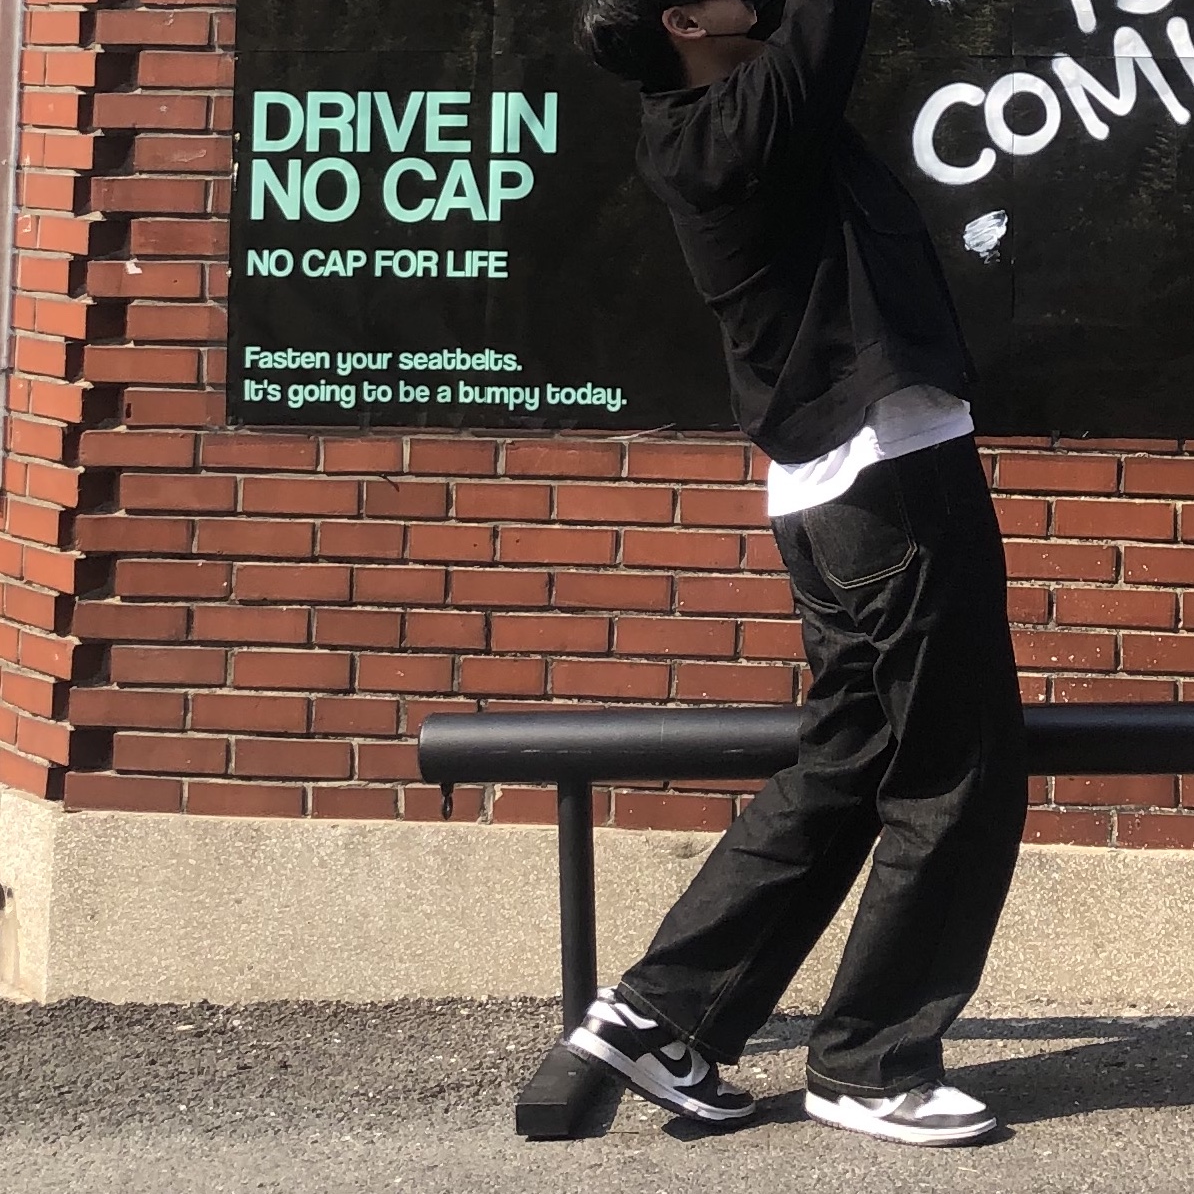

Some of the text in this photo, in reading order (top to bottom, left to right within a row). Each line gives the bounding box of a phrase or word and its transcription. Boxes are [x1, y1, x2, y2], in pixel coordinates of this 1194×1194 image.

[252, 91, 558, 154] DRIVE IN
[250, 158, 535, 223] NO CAP
[247, 249, 508, 278] NO CAP FOR LIFE
[244, 345, 523, 376] Fasten your seatbelts.
[243, 379, 628, 413] It's going to be a bumpy today.
